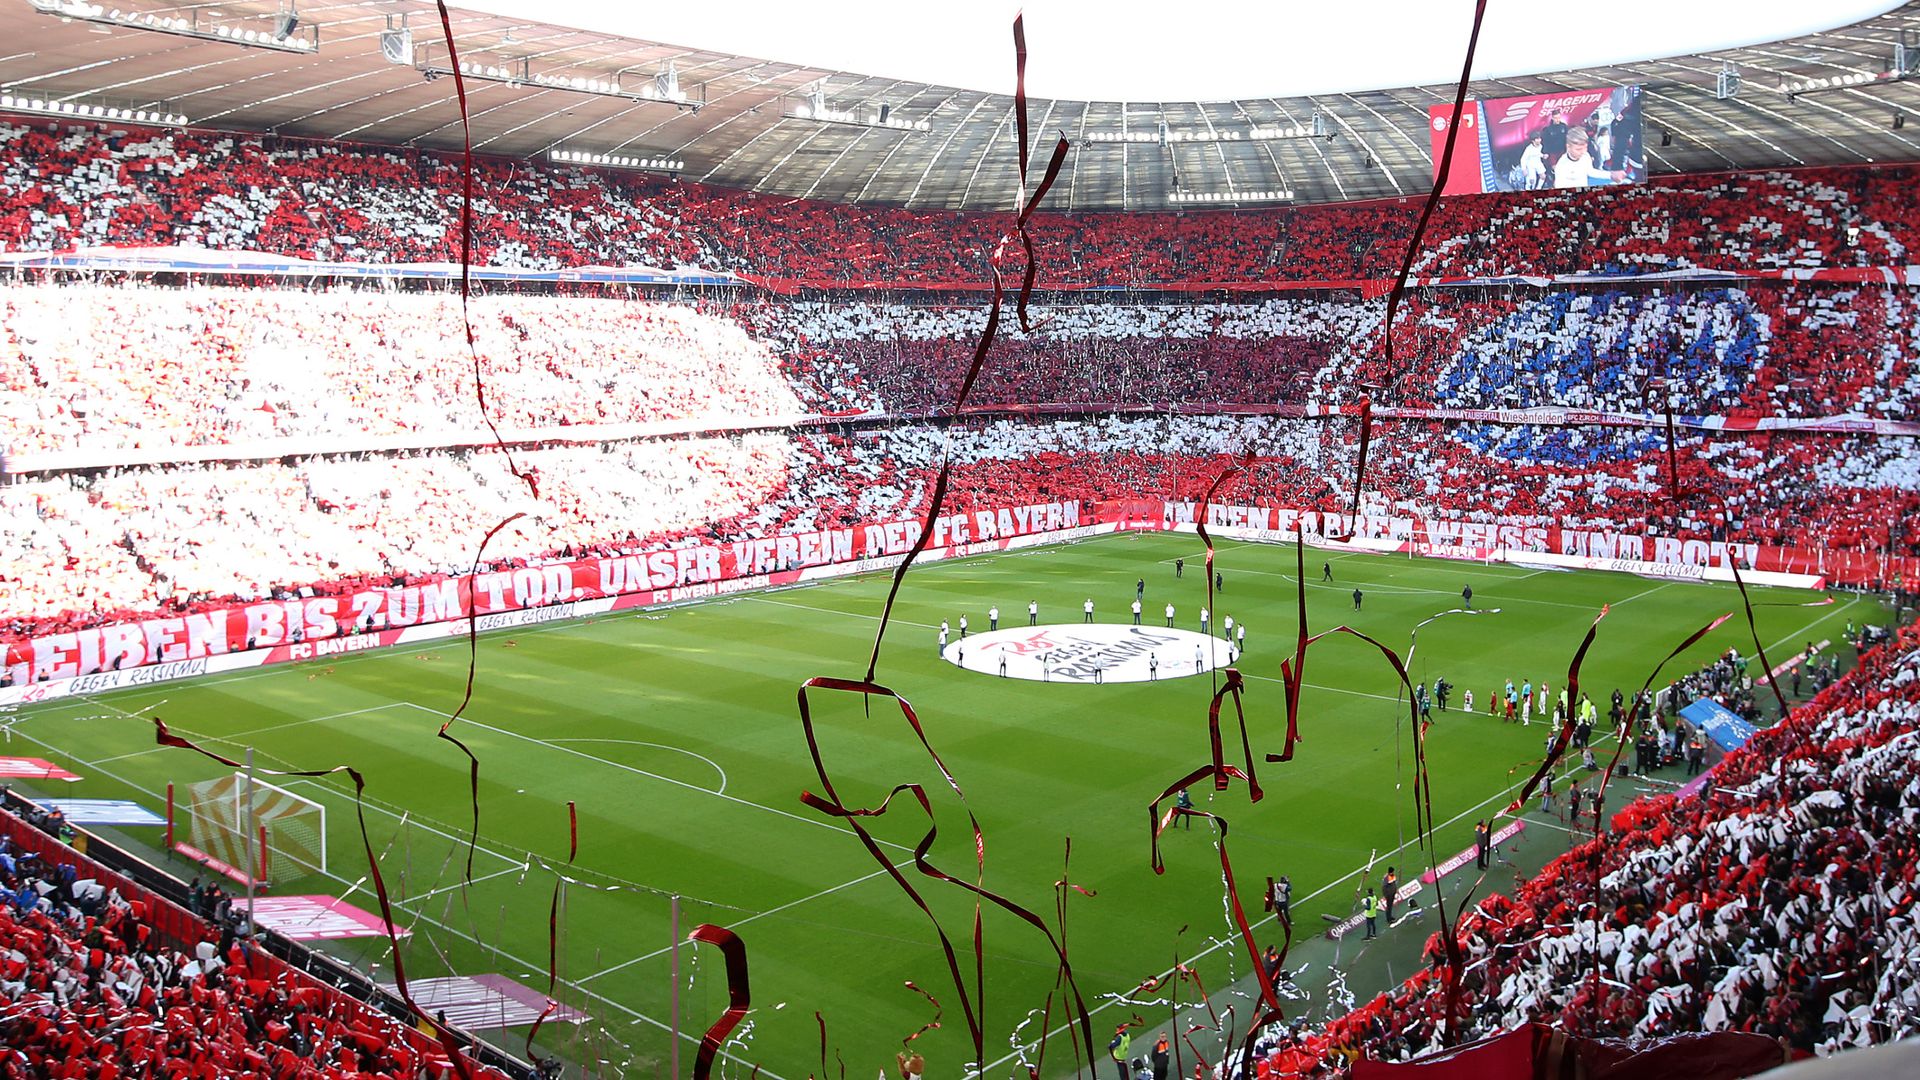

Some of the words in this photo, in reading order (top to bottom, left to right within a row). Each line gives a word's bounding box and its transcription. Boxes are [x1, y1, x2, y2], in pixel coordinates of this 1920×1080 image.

[1542, 92, 1603, 109] MAGENTA
[1501, 411, 1563, 424] Wiesenfelden
[1164, 501, 1195, 524] IN
[1207, 505, 1270, 531] DEN
[1425, 519, 1549, 553] WEISS
[1560, 528, 1644, 561] UND
[968, 541, 1000, 555] BAYERN
[1433, 543, 1477, 557] BAYERN
[244, 598, 338, 645] BIS
[351, 578, 462, 630] ZUM
[477, 564, 584, 613] TOD.
[599, 545, 722, 594] UNSER
[733, 528, 854, 575] VEREIN
[864, 520, 925, 556] DER
[933, 513, 969, 546] FC
[978, 500, 1079, 540] BAYERN
[652, 589, 668, 604] FC
[671, 582, 716, 602] BAYERN
[480, 611, 517, 630] GEGEN
[289, 643, 312, 660] FC
[316, 633, 381, 654] BAYERN
[70, 669, 121, 694] GEGEN
[129, 657, 209, 685] RASSISMUS
